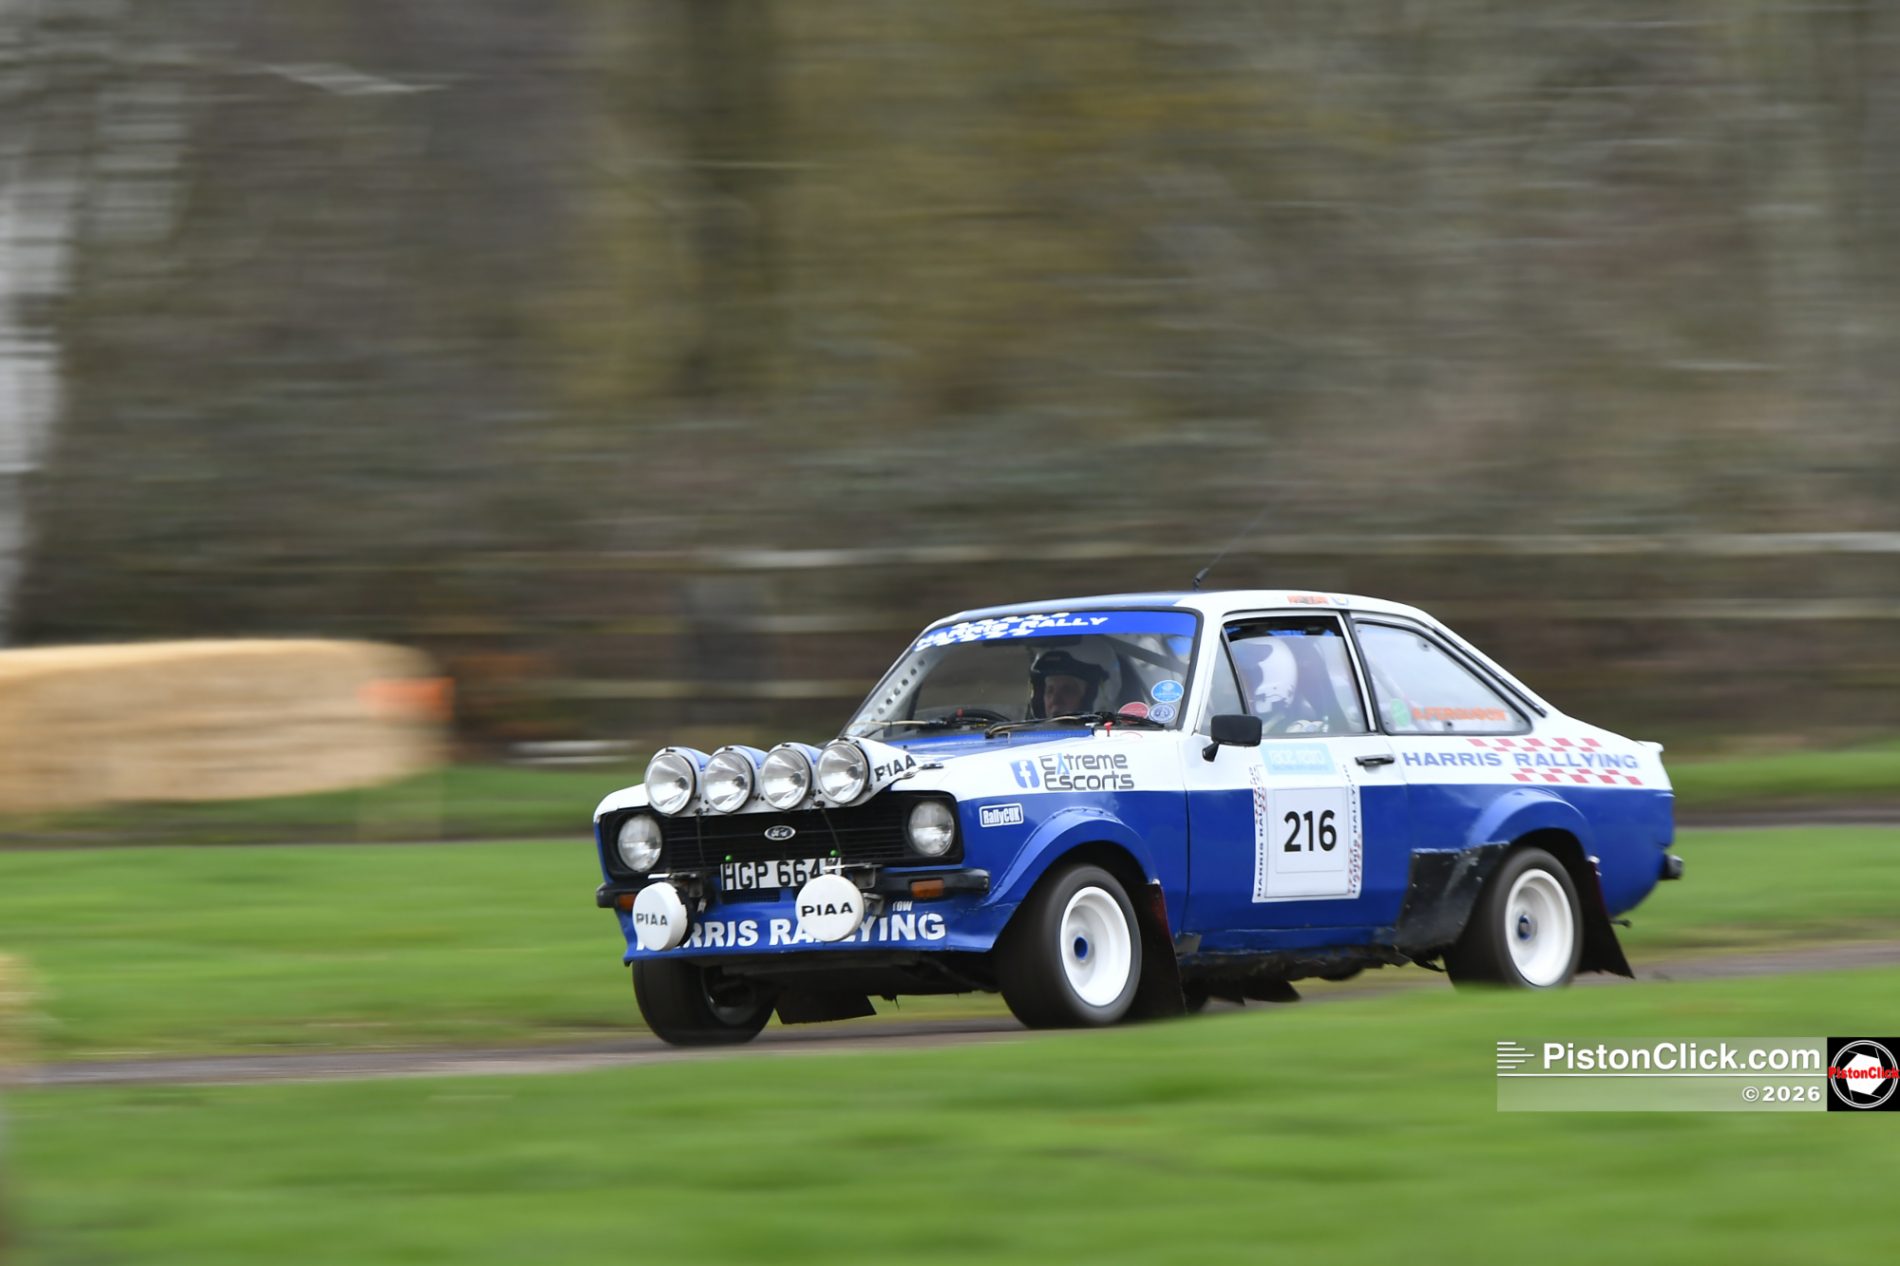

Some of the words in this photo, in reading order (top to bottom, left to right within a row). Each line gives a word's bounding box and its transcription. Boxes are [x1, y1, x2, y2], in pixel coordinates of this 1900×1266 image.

[1018, 617, 1109, 631] RALLY
[874, 754, 917, 782] PIAA
[1402, 752, 1503, 766] HARRIS
[1513, 752, 1639, 769] RALLYING
[1043, 771, 1135, 791] Escorts
[1284, 809, 1338, 853] 216
[722, 861, 769, 891] HGP
[635, 912, 668, 926] PIAA
[801, 901, 854, 917] PIAA
[768, 912, 946, 946] RAYING
